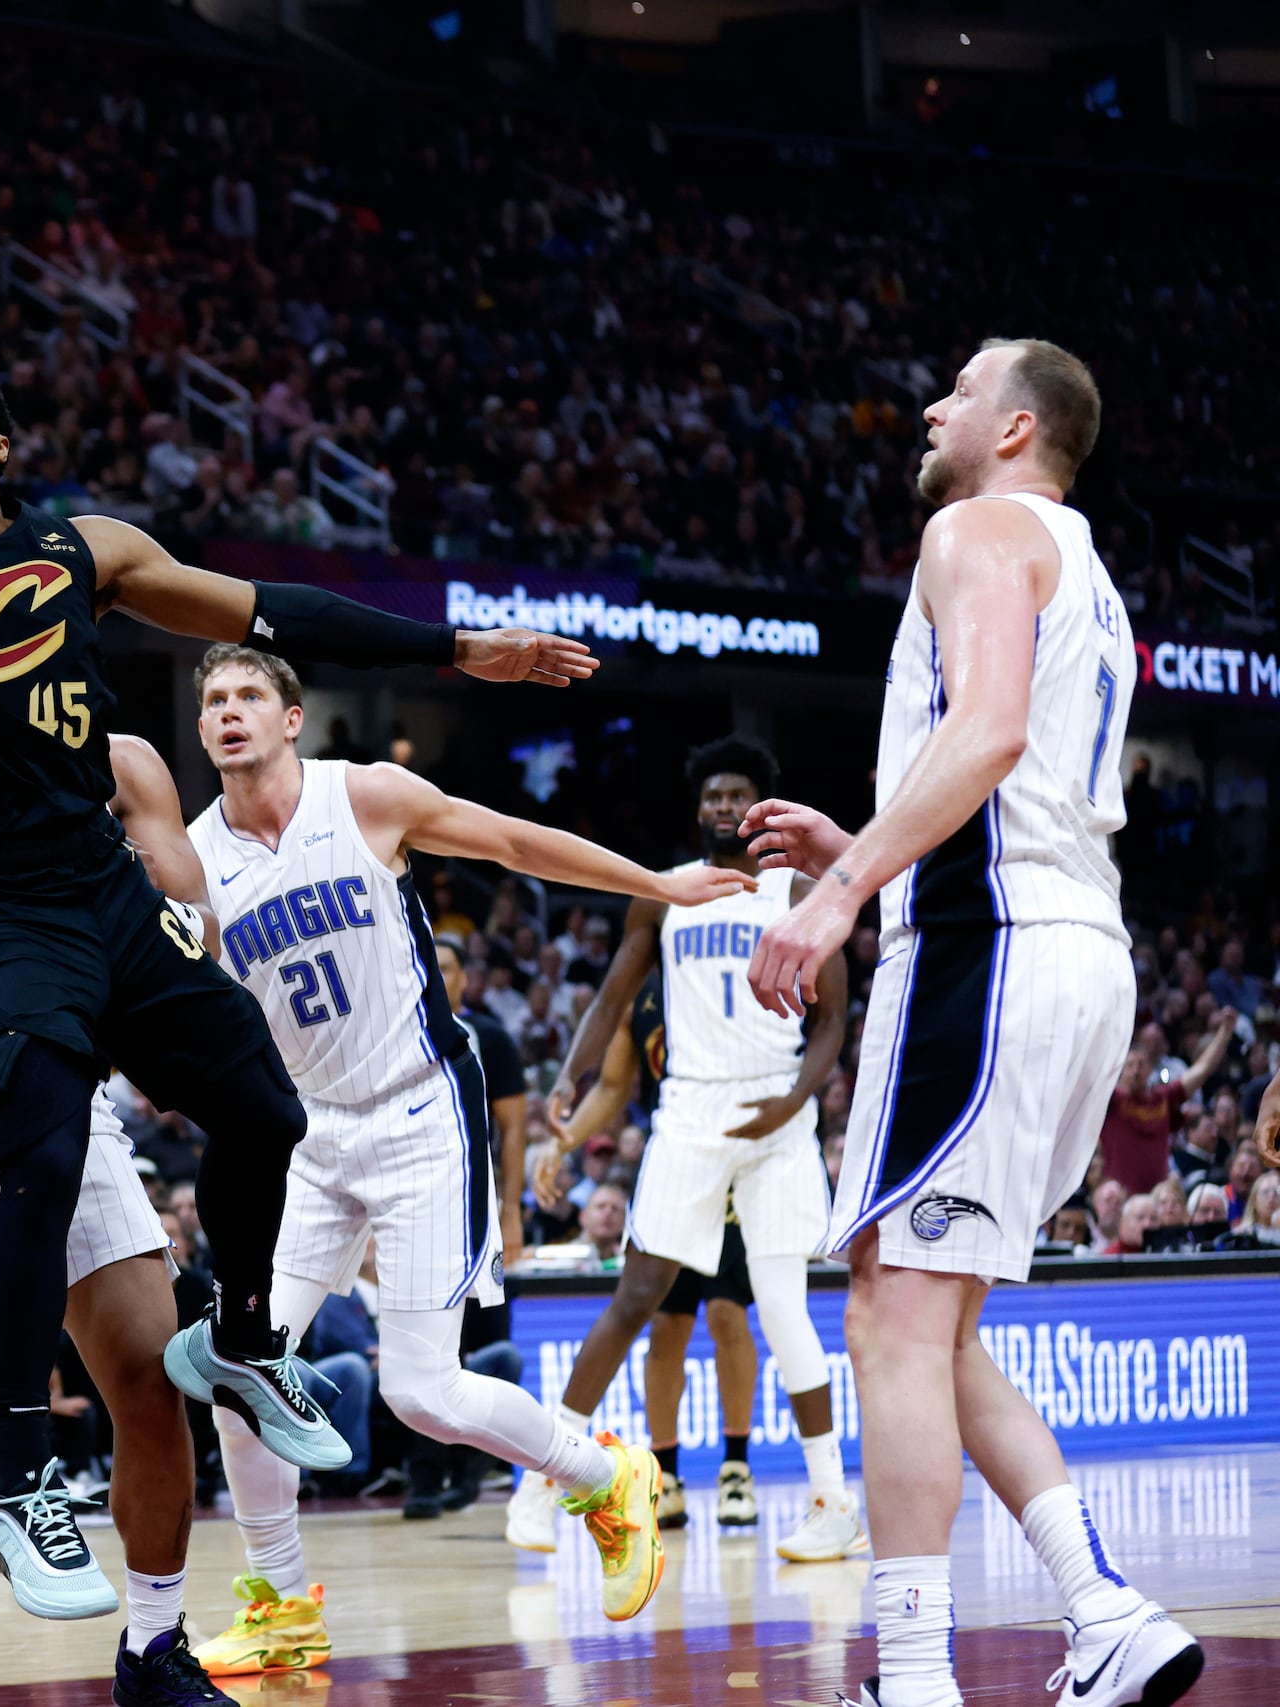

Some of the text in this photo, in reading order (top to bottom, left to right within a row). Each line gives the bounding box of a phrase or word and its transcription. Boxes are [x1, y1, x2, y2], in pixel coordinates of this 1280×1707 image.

[40, 542, 78, 553] CLIFFS
[445, 580, 821, 659] RocketMortgage.com
[1248, 650, 1280, 699] M
[28, 680, 92, 750] 45
[1087, 655, 1117, 808] 7
[222, 875, 376, 982] MAGIC
[673, 921, 764, 968] MAGI
[278, 950, 352, 1029] 21
[720, 971, 734, 1019] 1
